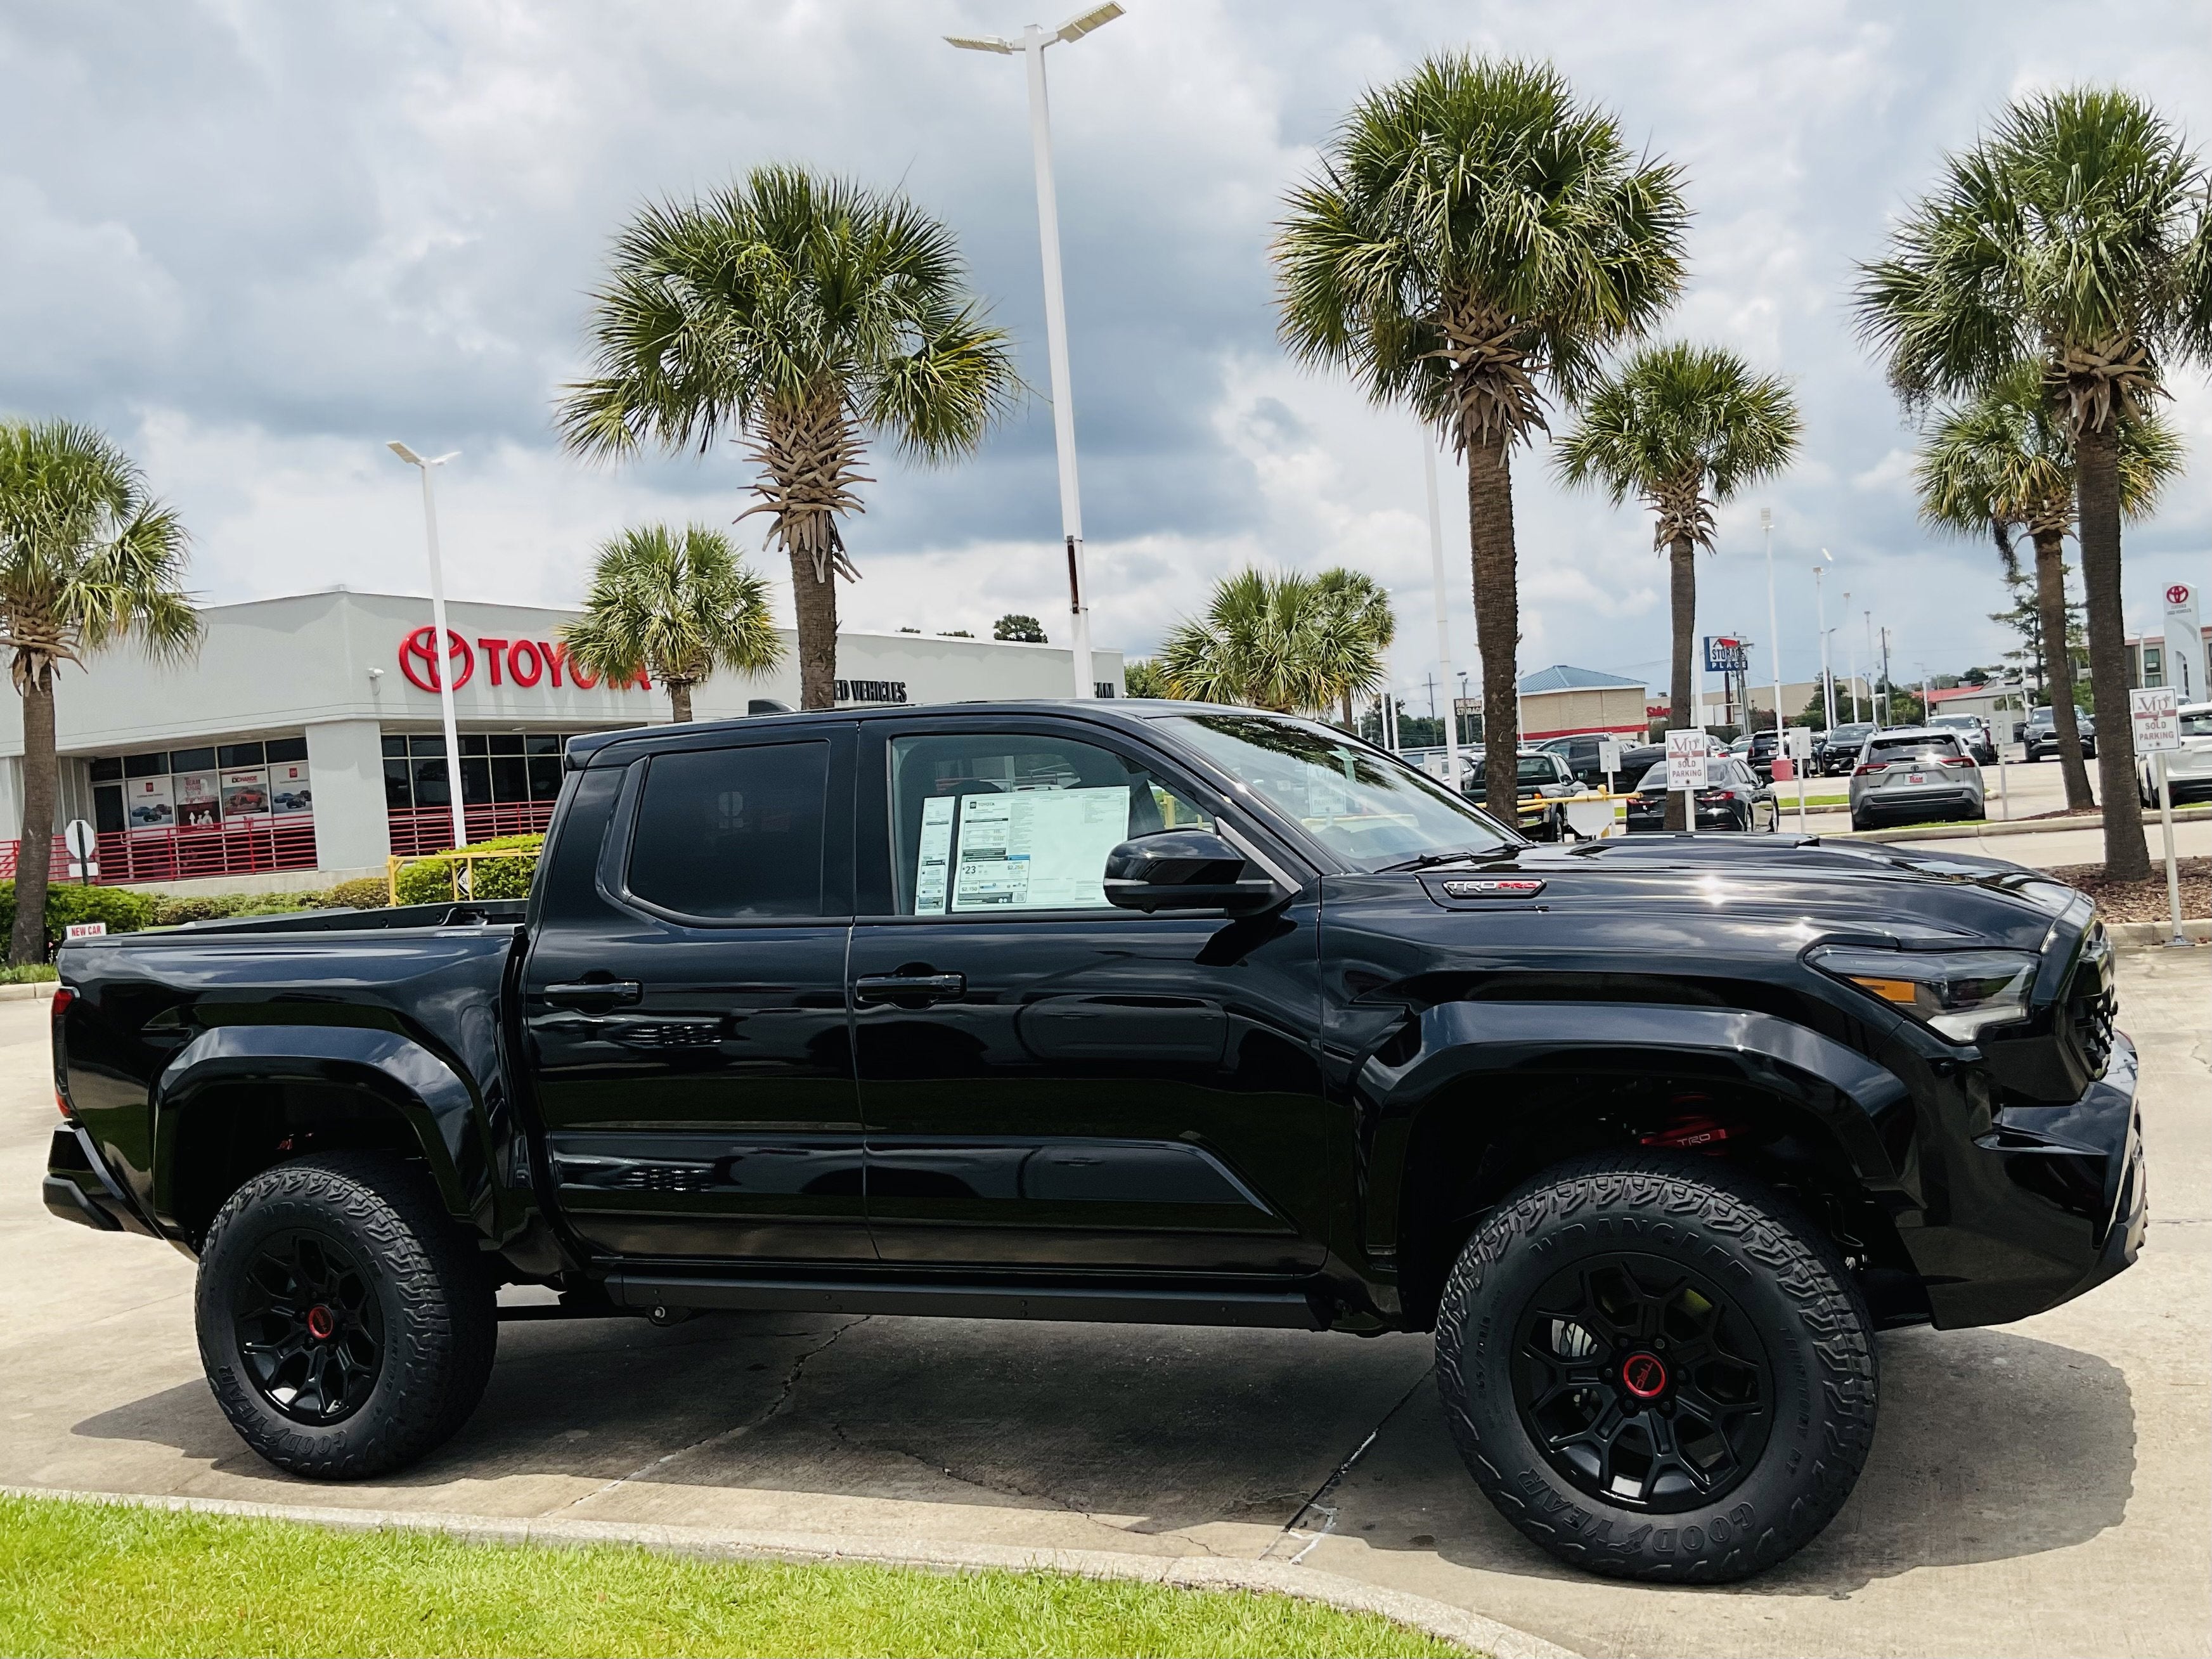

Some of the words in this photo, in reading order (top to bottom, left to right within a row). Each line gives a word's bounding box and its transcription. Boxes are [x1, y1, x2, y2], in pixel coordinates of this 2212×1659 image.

[478, 638, 652, 690] TOYOA
[850, 680, 907, 703] VEHICLES
[2145, 721, 2166, 730] SOLD
[2139, 731, 2175, 740] PARKING
[965, 866, 976, 874] 23
[1448, 881, 1497, 893] TRD
[72, 926, 86, 936] NEW
[88, 926, 101, 935] CAR
[1677, 1133, 1711, 1146] TRD
[1529, 1217, 1753, 1281] WRANGLER
[1636, 1362, 1653, 1390] TRD
[218, 1364, 347, 1456] GOODYEAR
[1517, 1468, 1757, 1554] GOODYEAR
